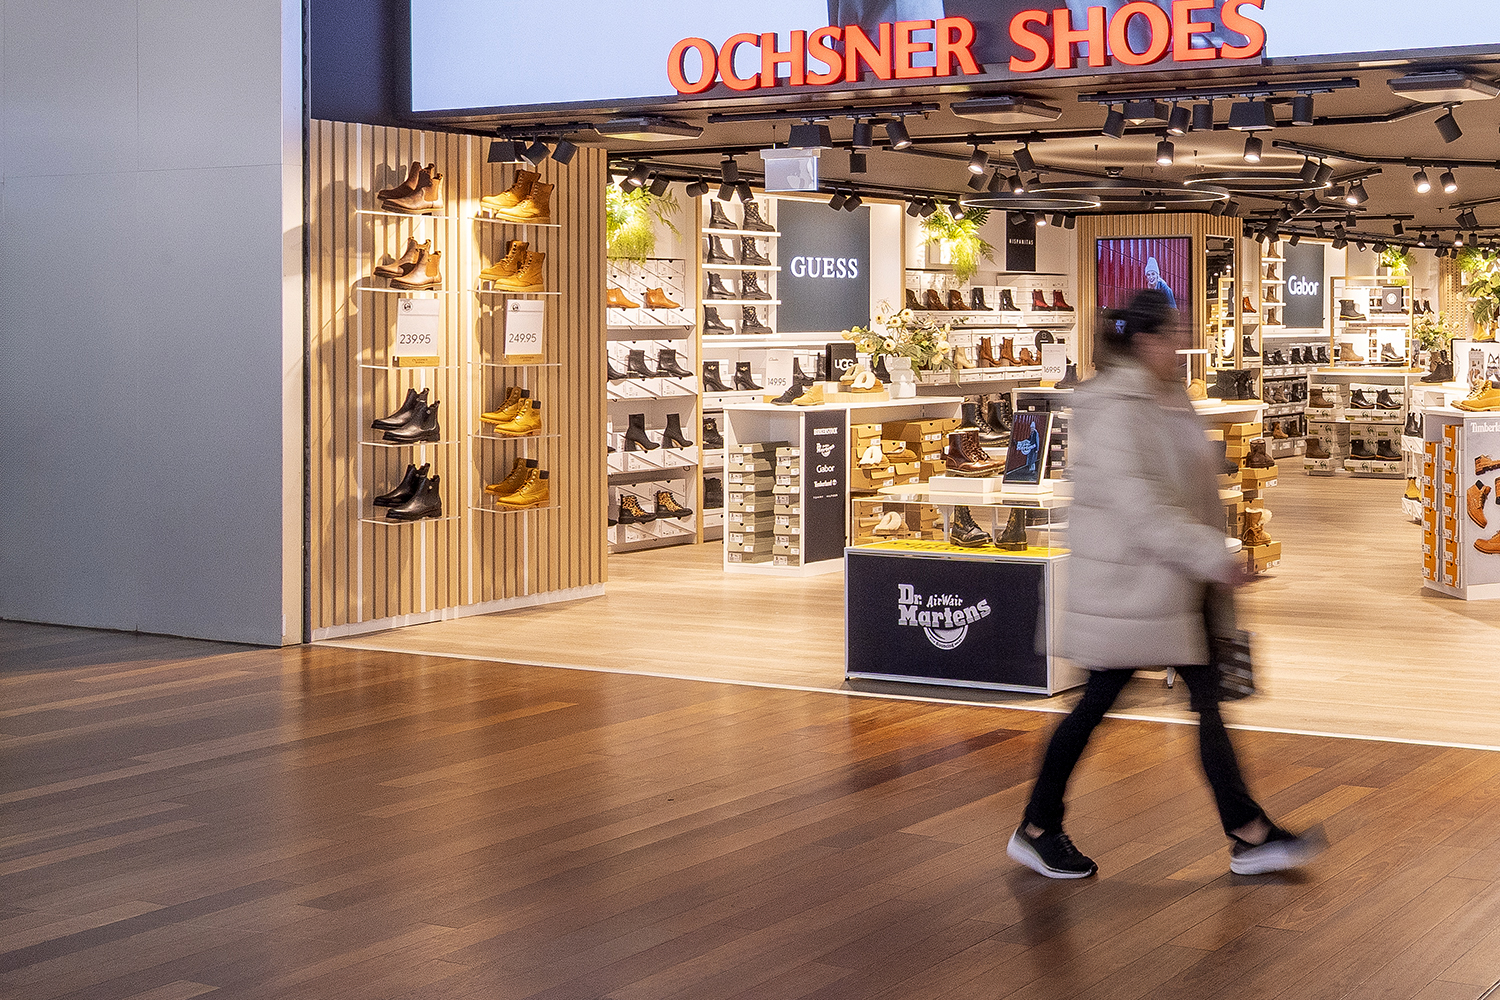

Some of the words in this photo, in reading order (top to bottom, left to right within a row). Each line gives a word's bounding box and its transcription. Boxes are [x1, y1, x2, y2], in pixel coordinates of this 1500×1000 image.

[667, 17, 980, 94] OCHSNER
[790, 256, 859, 278] GUESS
[1287, 275, 1319, 296] Gabor
[400, 333, 431, 345] 239.95
[508, 332, 537, 344] 249.95
[898, 583, 923, 605] Dr.
[926, 593, 964, 608] AirWair
[898, 599, 992, 628] Martens
